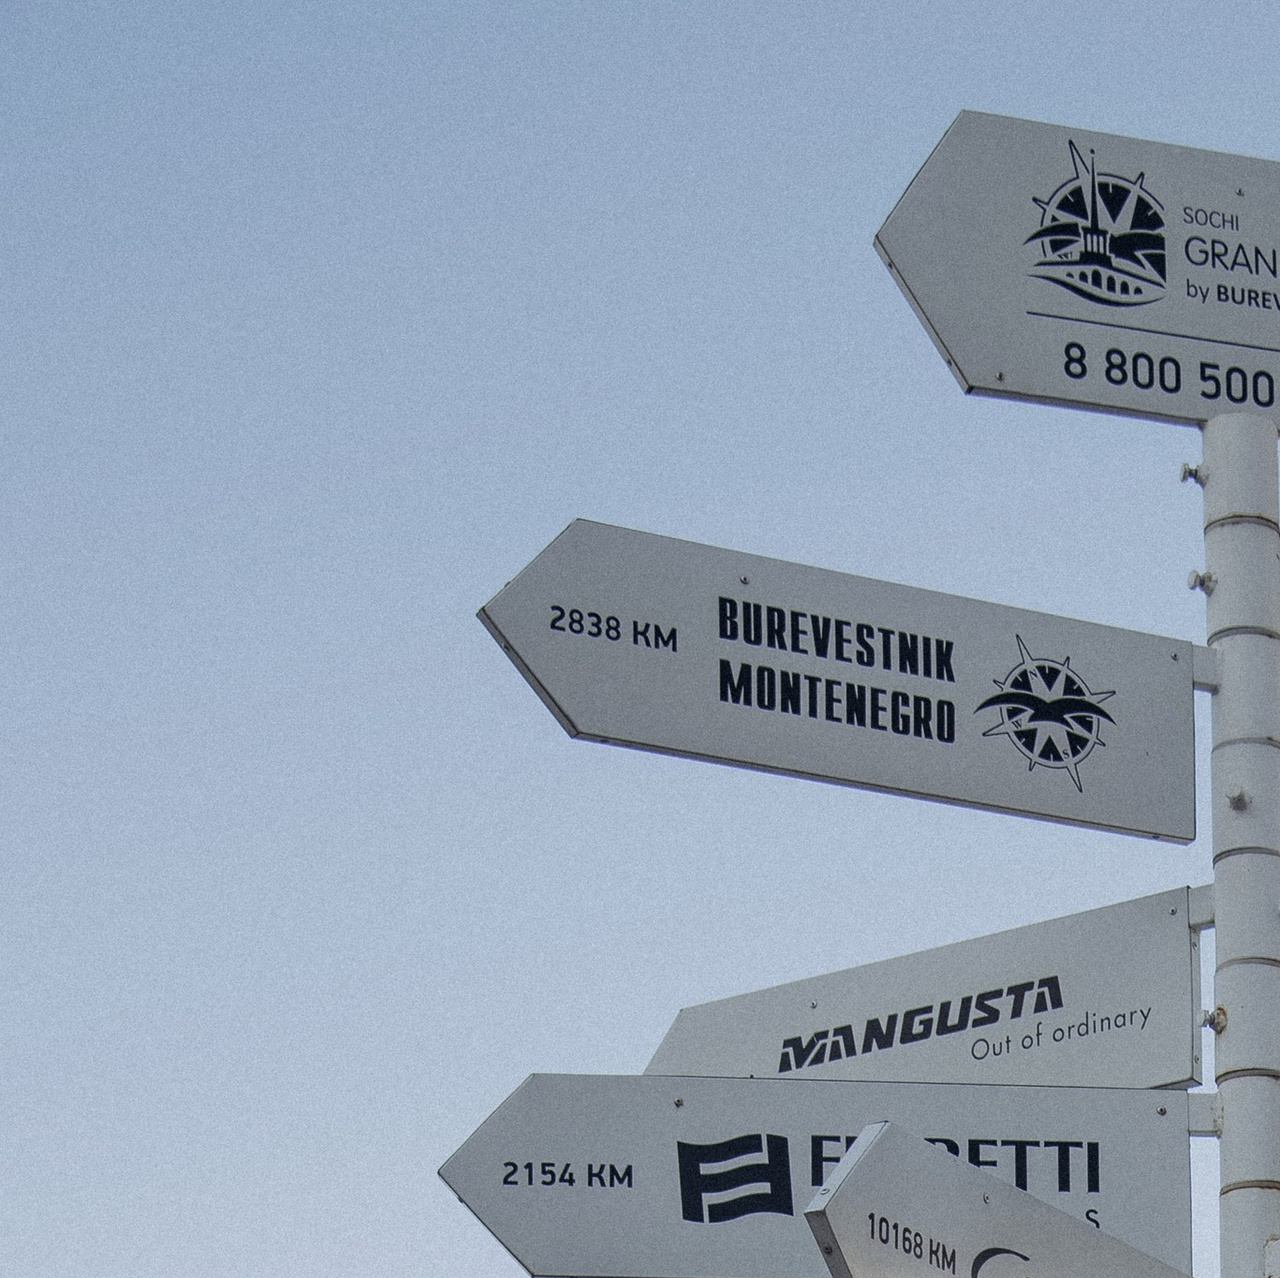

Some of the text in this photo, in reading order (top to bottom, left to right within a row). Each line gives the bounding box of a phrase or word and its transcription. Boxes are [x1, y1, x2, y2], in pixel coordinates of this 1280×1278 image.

[1183, 207, 1240, 231] SOCHI
[1186, 279, 1210, 304] by
[1063, 343, 1087, 379] 8
[1105, 349, 1182, 394] 800
[1200, 365, 1275, 408] 500
[550, 605, 621, 641] 2838
[718, 596, 956, 683] BUREVESTNIK
[719, 659, 956, 744] MONTENEGRO
[778, 975, 1064, 1073] MANGUSTA
[971, 1007, 1152, 1060] Out of ordinary
[503, 1161, 575, 1187] 2154
[868, 1212, 923, 1259] 10168
